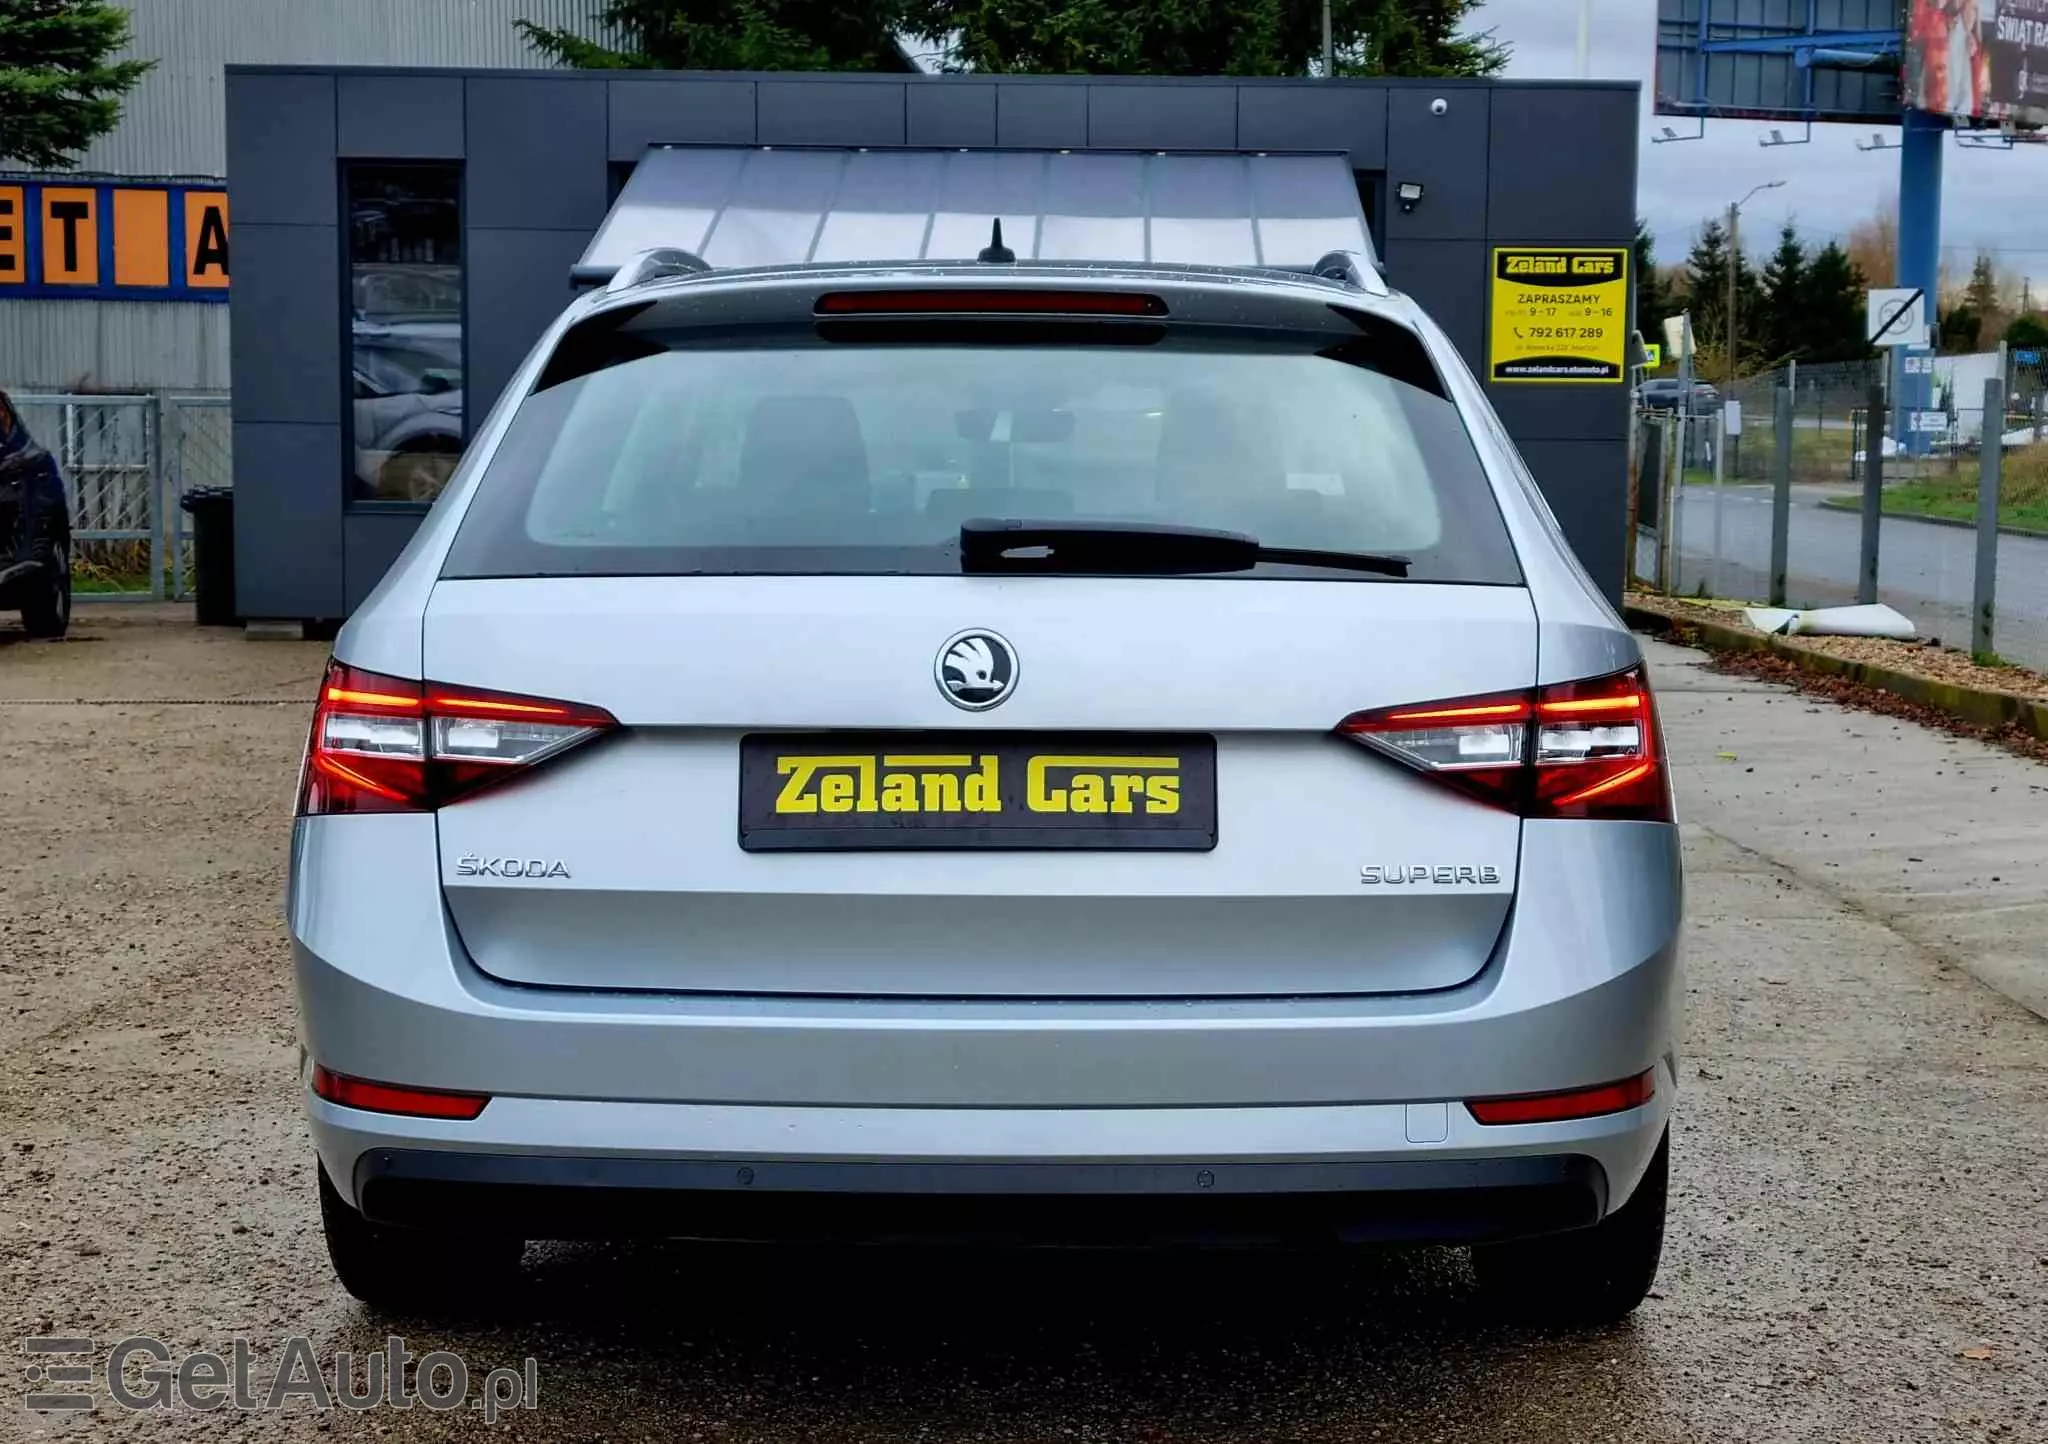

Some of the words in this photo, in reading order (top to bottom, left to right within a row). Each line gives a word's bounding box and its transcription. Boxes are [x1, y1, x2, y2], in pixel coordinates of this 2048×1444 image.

[1506, 256, 1567, 273] Zeland
[1572, 256, 1614, 273] Cars
[1518, 294, 1600, 304] ZAPRASZAMY
[1529, 327, 1552, 338] 792
[1555, 327, 1577, 338] 617
[1579, 327, 1604, 338] 289
[776, 755, 1001, 814] Zeland
[1027, 755, 1179, 814] Cars
[456, 850, 571, 879] ŠKODA
[1360, 864, 1501, 885] SUPERB
